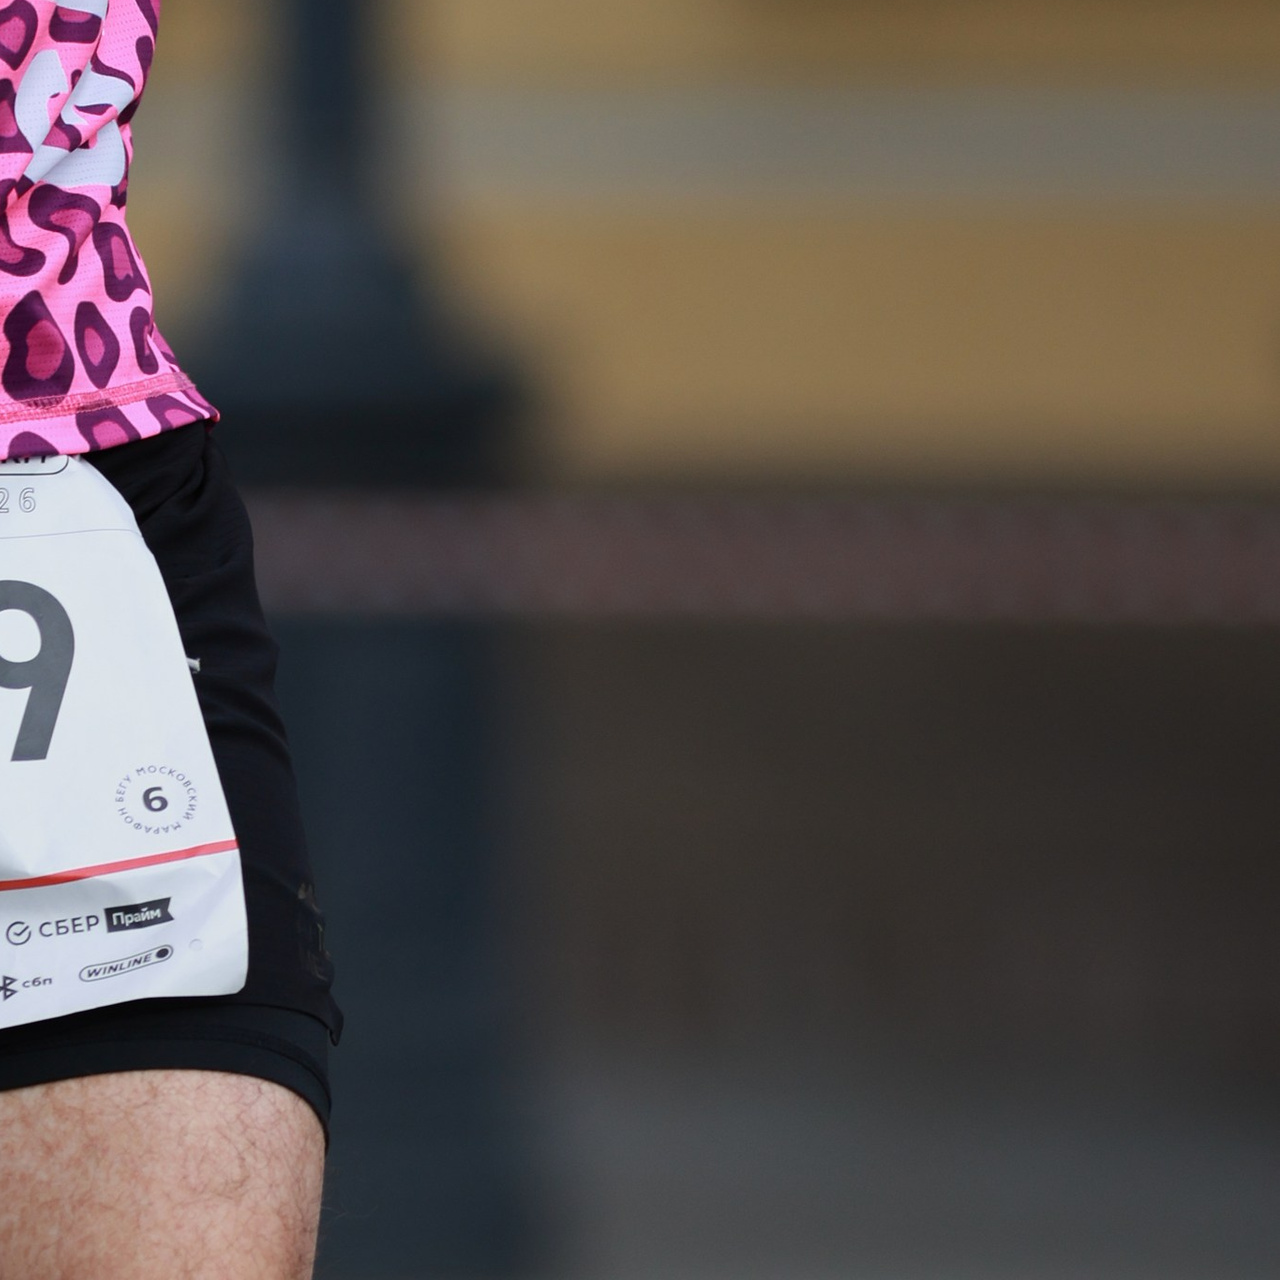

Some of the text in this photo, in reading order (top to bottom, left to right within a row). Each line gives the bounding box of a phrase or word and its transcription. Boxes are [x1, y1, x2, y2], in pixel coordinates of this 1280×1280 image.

[115, 765, 197, 835] БЕГУ МОСКОВСКИЙ МАРАФОН
[142, 786, 169, 813] 6
[38, 907, 162, 938] СБЕР Прайм
[86, 952, 152, 979] WINLINE
